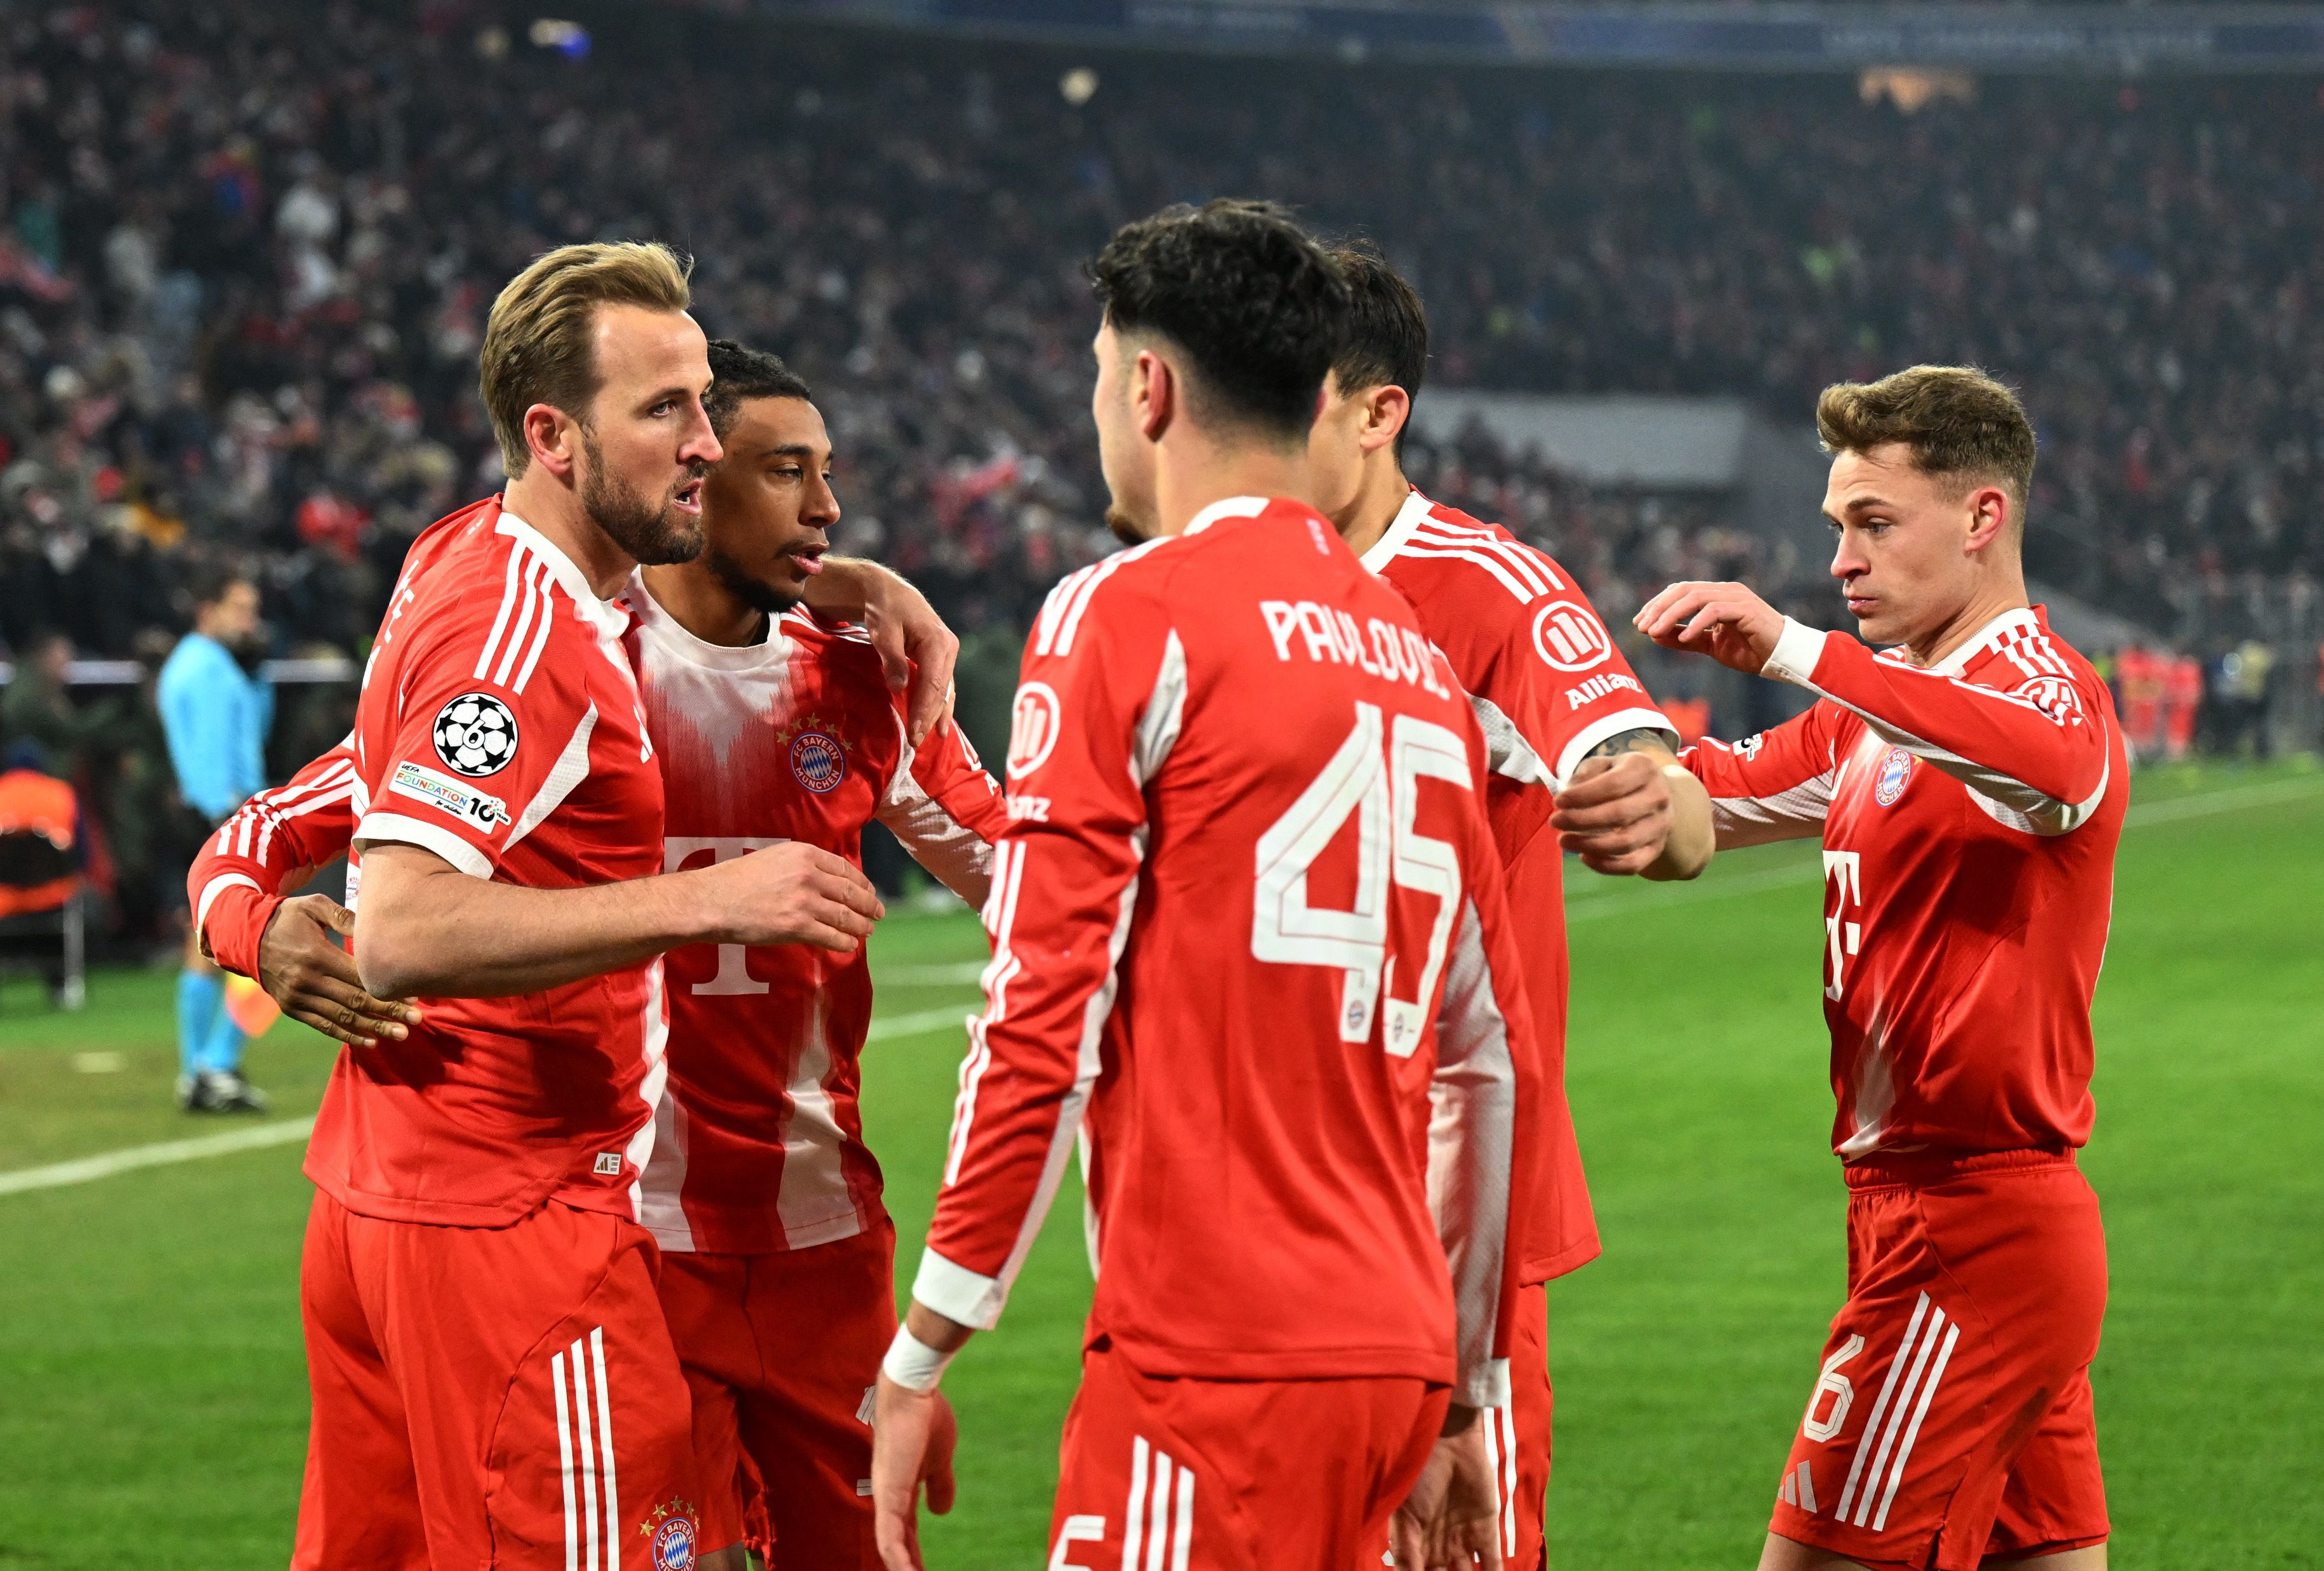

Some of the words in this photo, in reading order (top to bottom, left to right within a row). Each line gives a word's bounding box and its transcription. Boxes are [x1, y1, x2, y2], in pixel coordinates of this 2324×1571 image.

[462, 718, 485, 749] 6
[794, 744, 803, 757] FC
[802, 737, 839, 760] BAYERN
[401, 764, 419, 773] UEFA
[470, 797, 495, 822] 10
[1250, 700, 1473, 1060] 45
[1804, 1334, 1865, 1443] 6
[657, 1532, 667, 1547] FC
[667, 1522, 693, 1544] BAYERN
